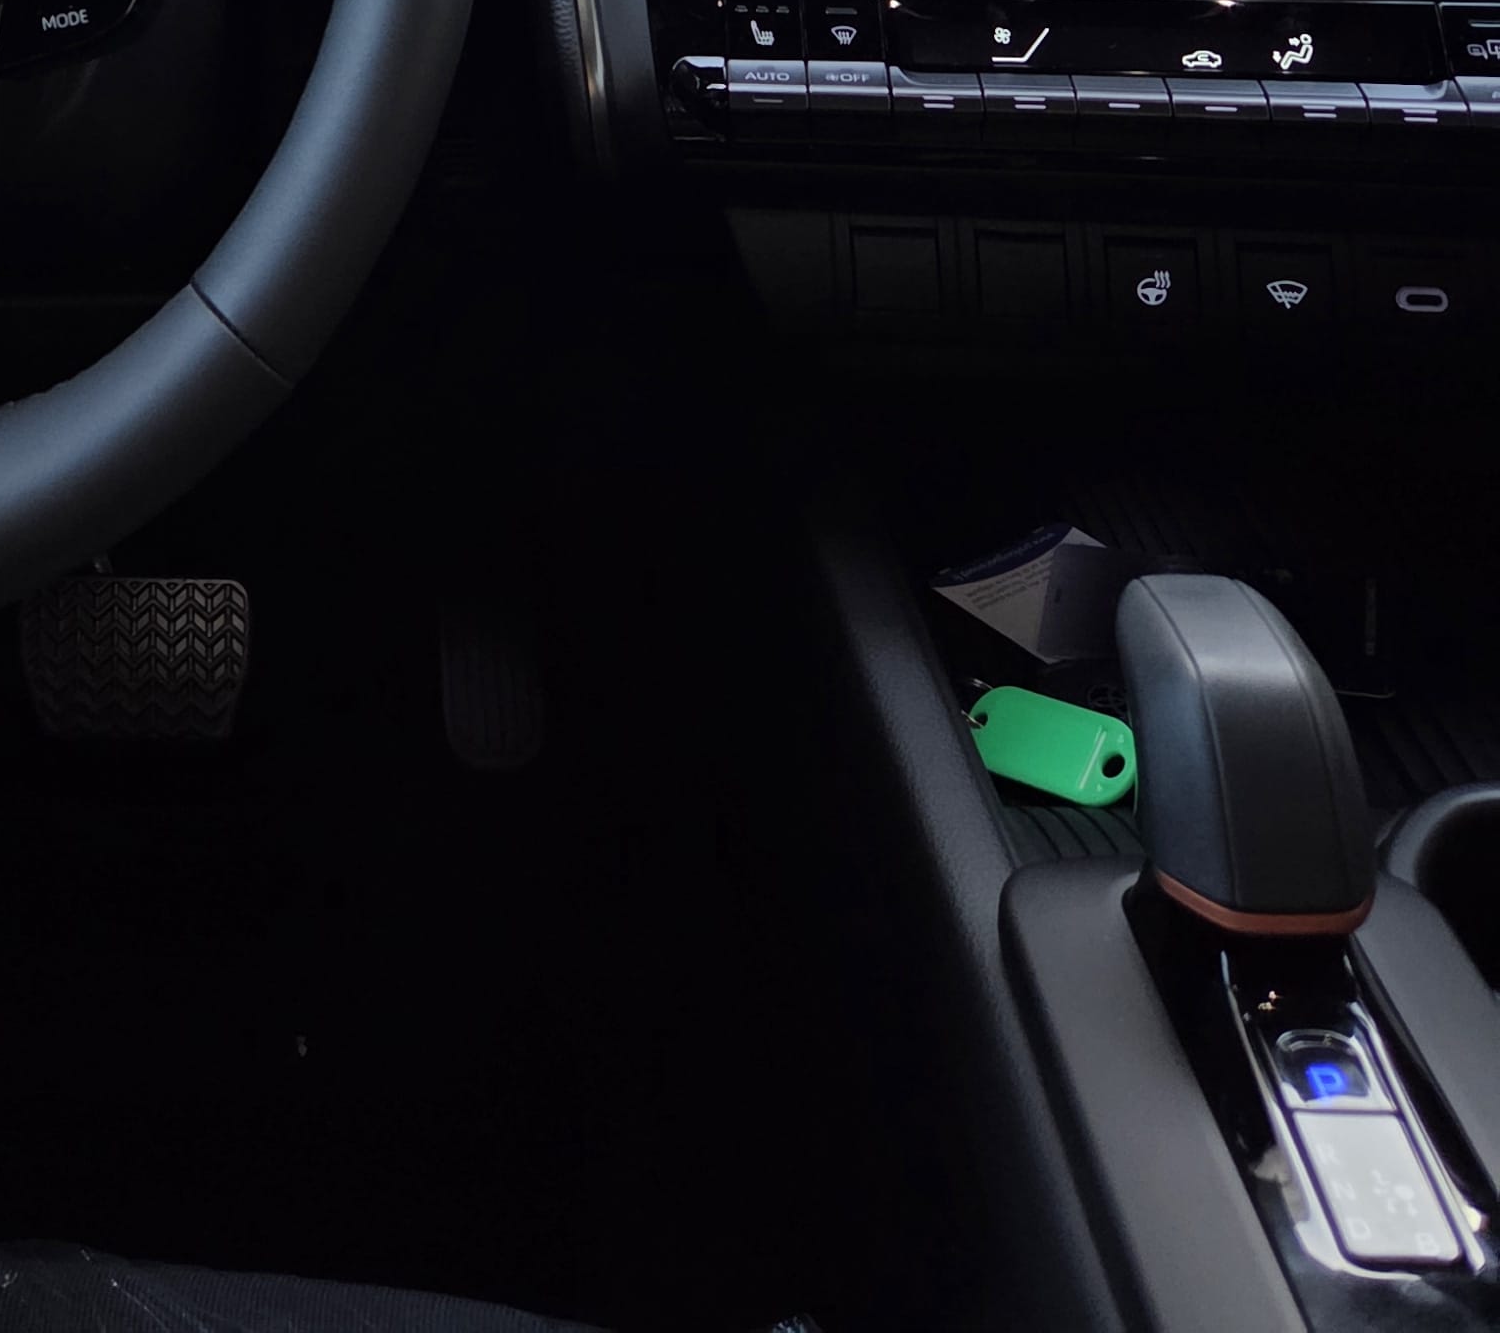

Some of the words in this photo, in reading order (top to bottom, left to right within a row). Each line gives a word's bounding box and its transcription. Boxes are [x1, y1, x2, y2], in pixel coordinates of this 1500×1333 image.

[41, 8, 91, 32] MODE
[744, 71, 790, 82] AUTO
[839, 73, 871, 83] OFF
[1306, 1064, 1347, 1100] P
[1345, 1217, 1372, 1240] D
[1414, 1231, 1441, 1256] B
